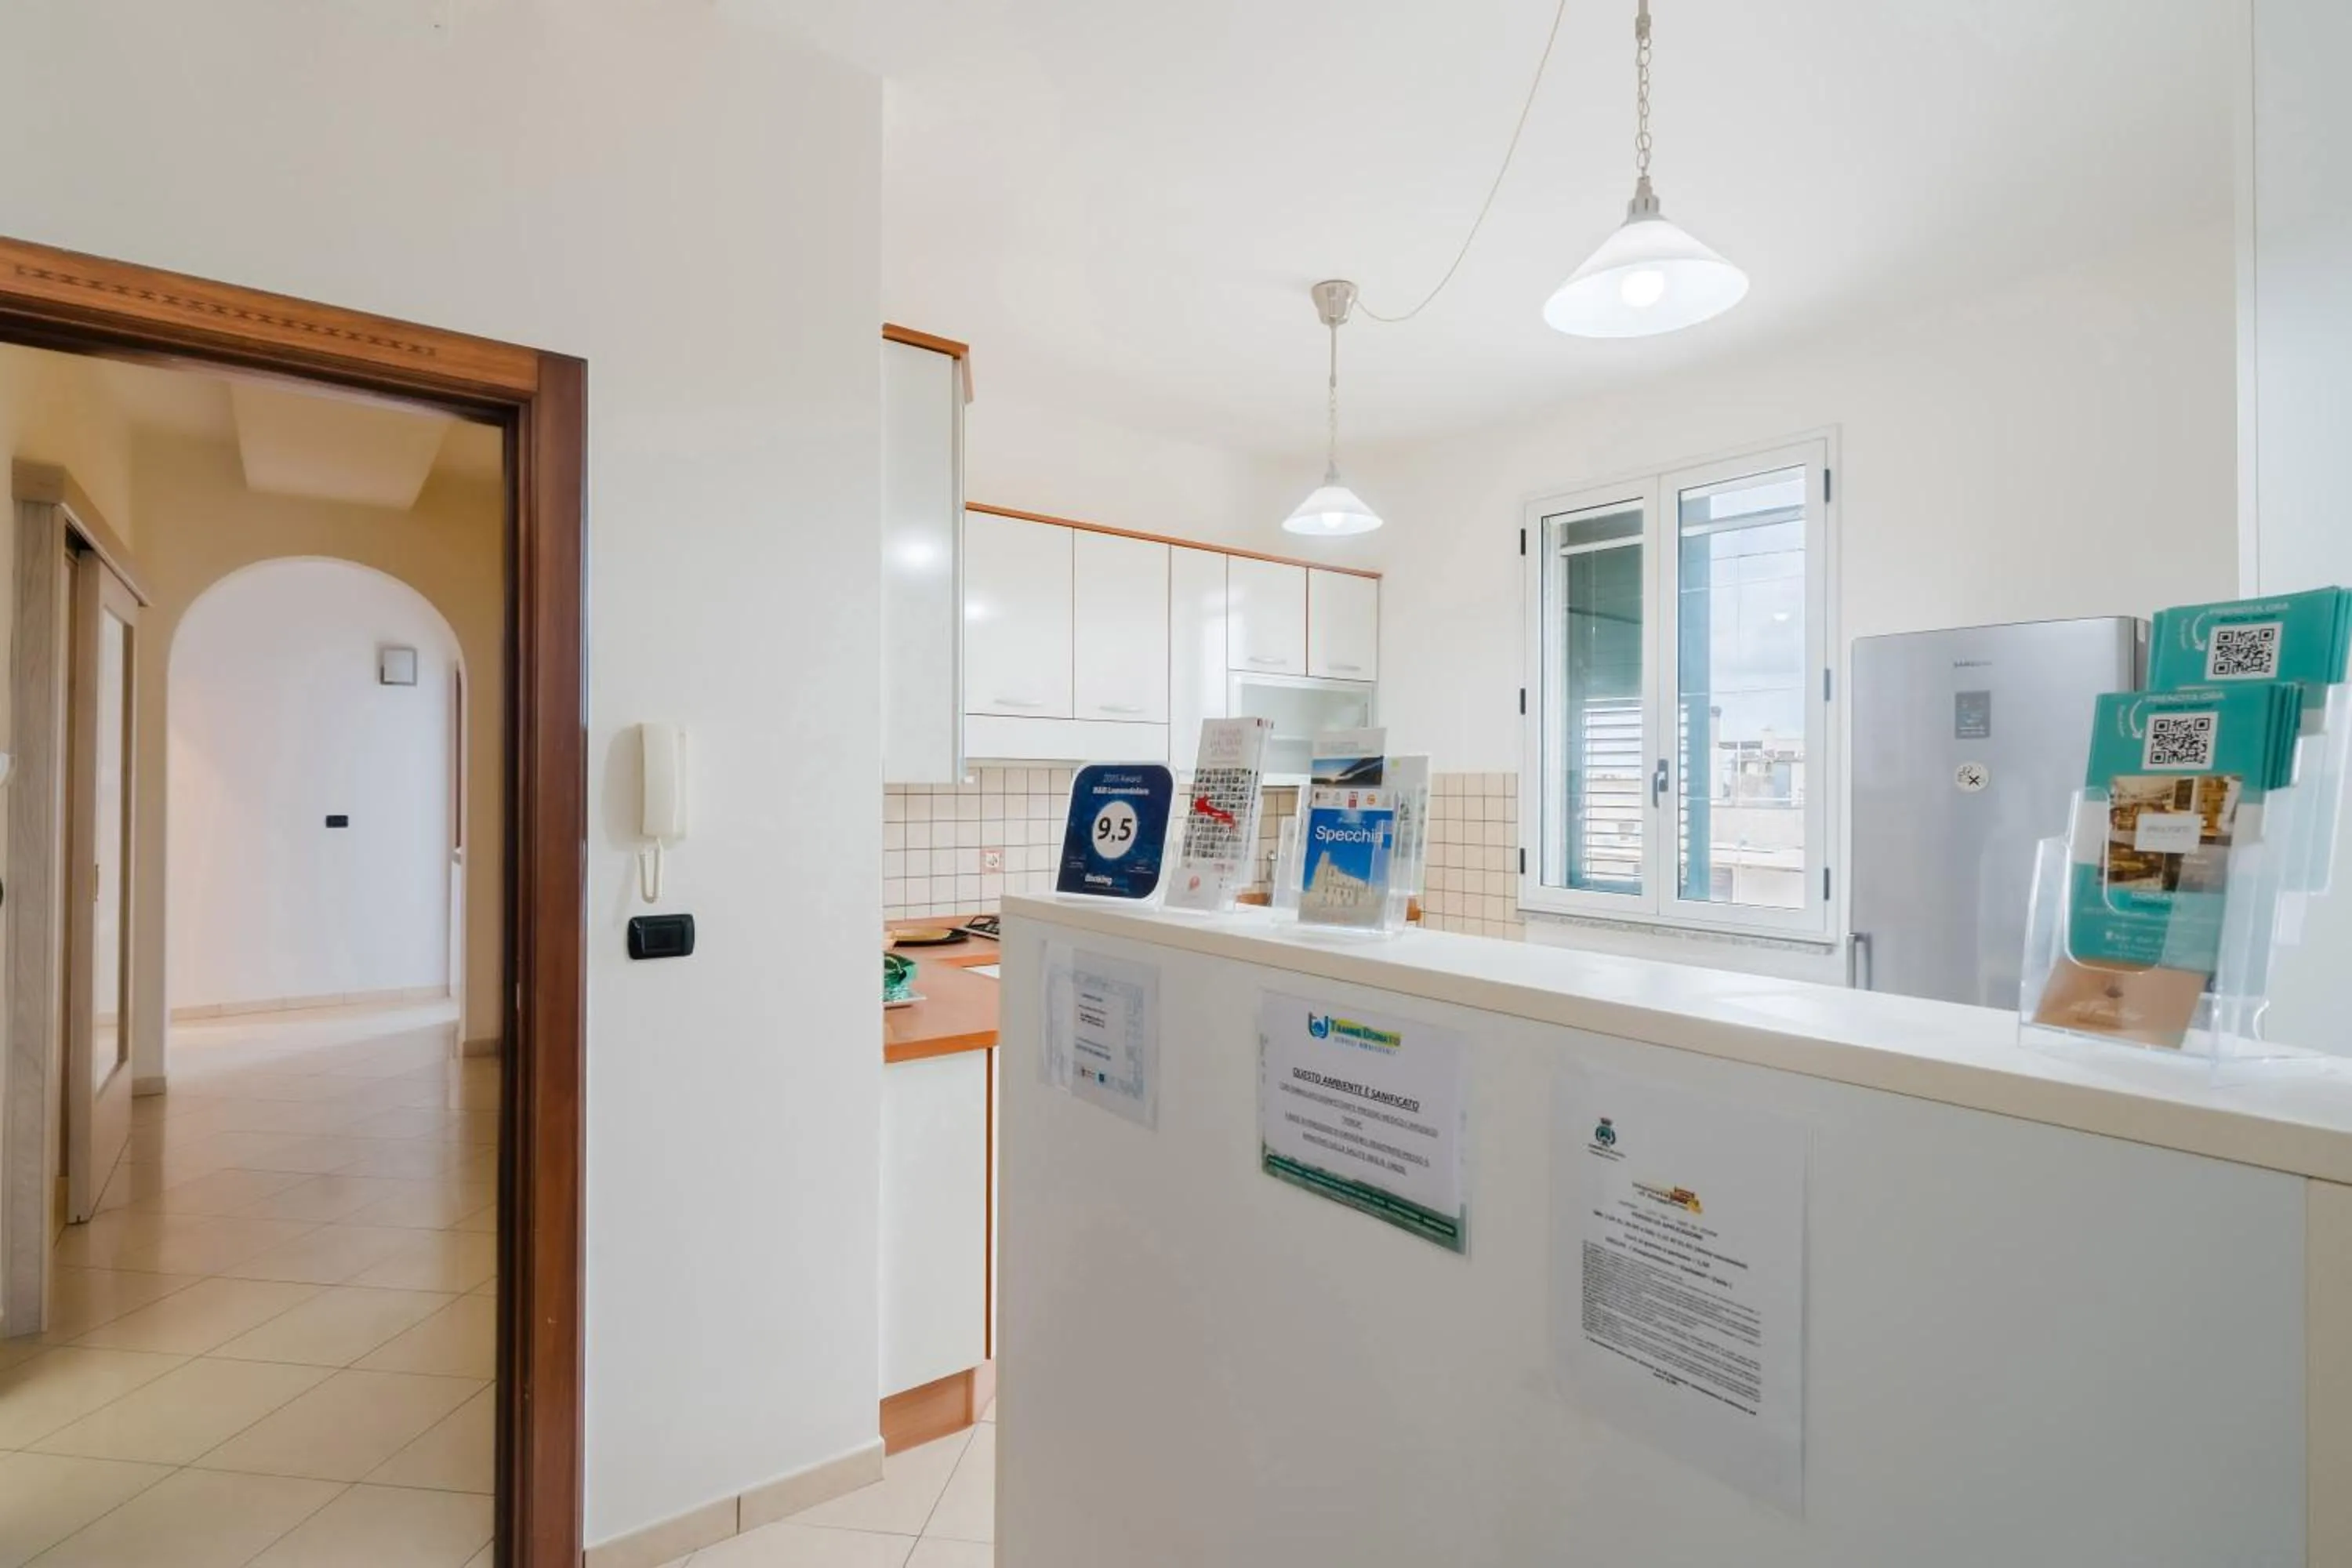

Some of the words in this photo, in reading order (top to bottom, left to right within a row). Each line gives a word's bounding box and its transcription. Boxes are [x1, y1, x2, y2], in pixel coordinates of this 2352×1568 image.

[1098, 816, 1133, 843] 9,5
[1315, 826, 1383, 844] Specchia
[1293, 1067, 1321, 1084] QUESTO
[1322, 1076, 1363, 1097] AMBIENTE
[1371, 1089, 1420, 1113] SANIFICATO
